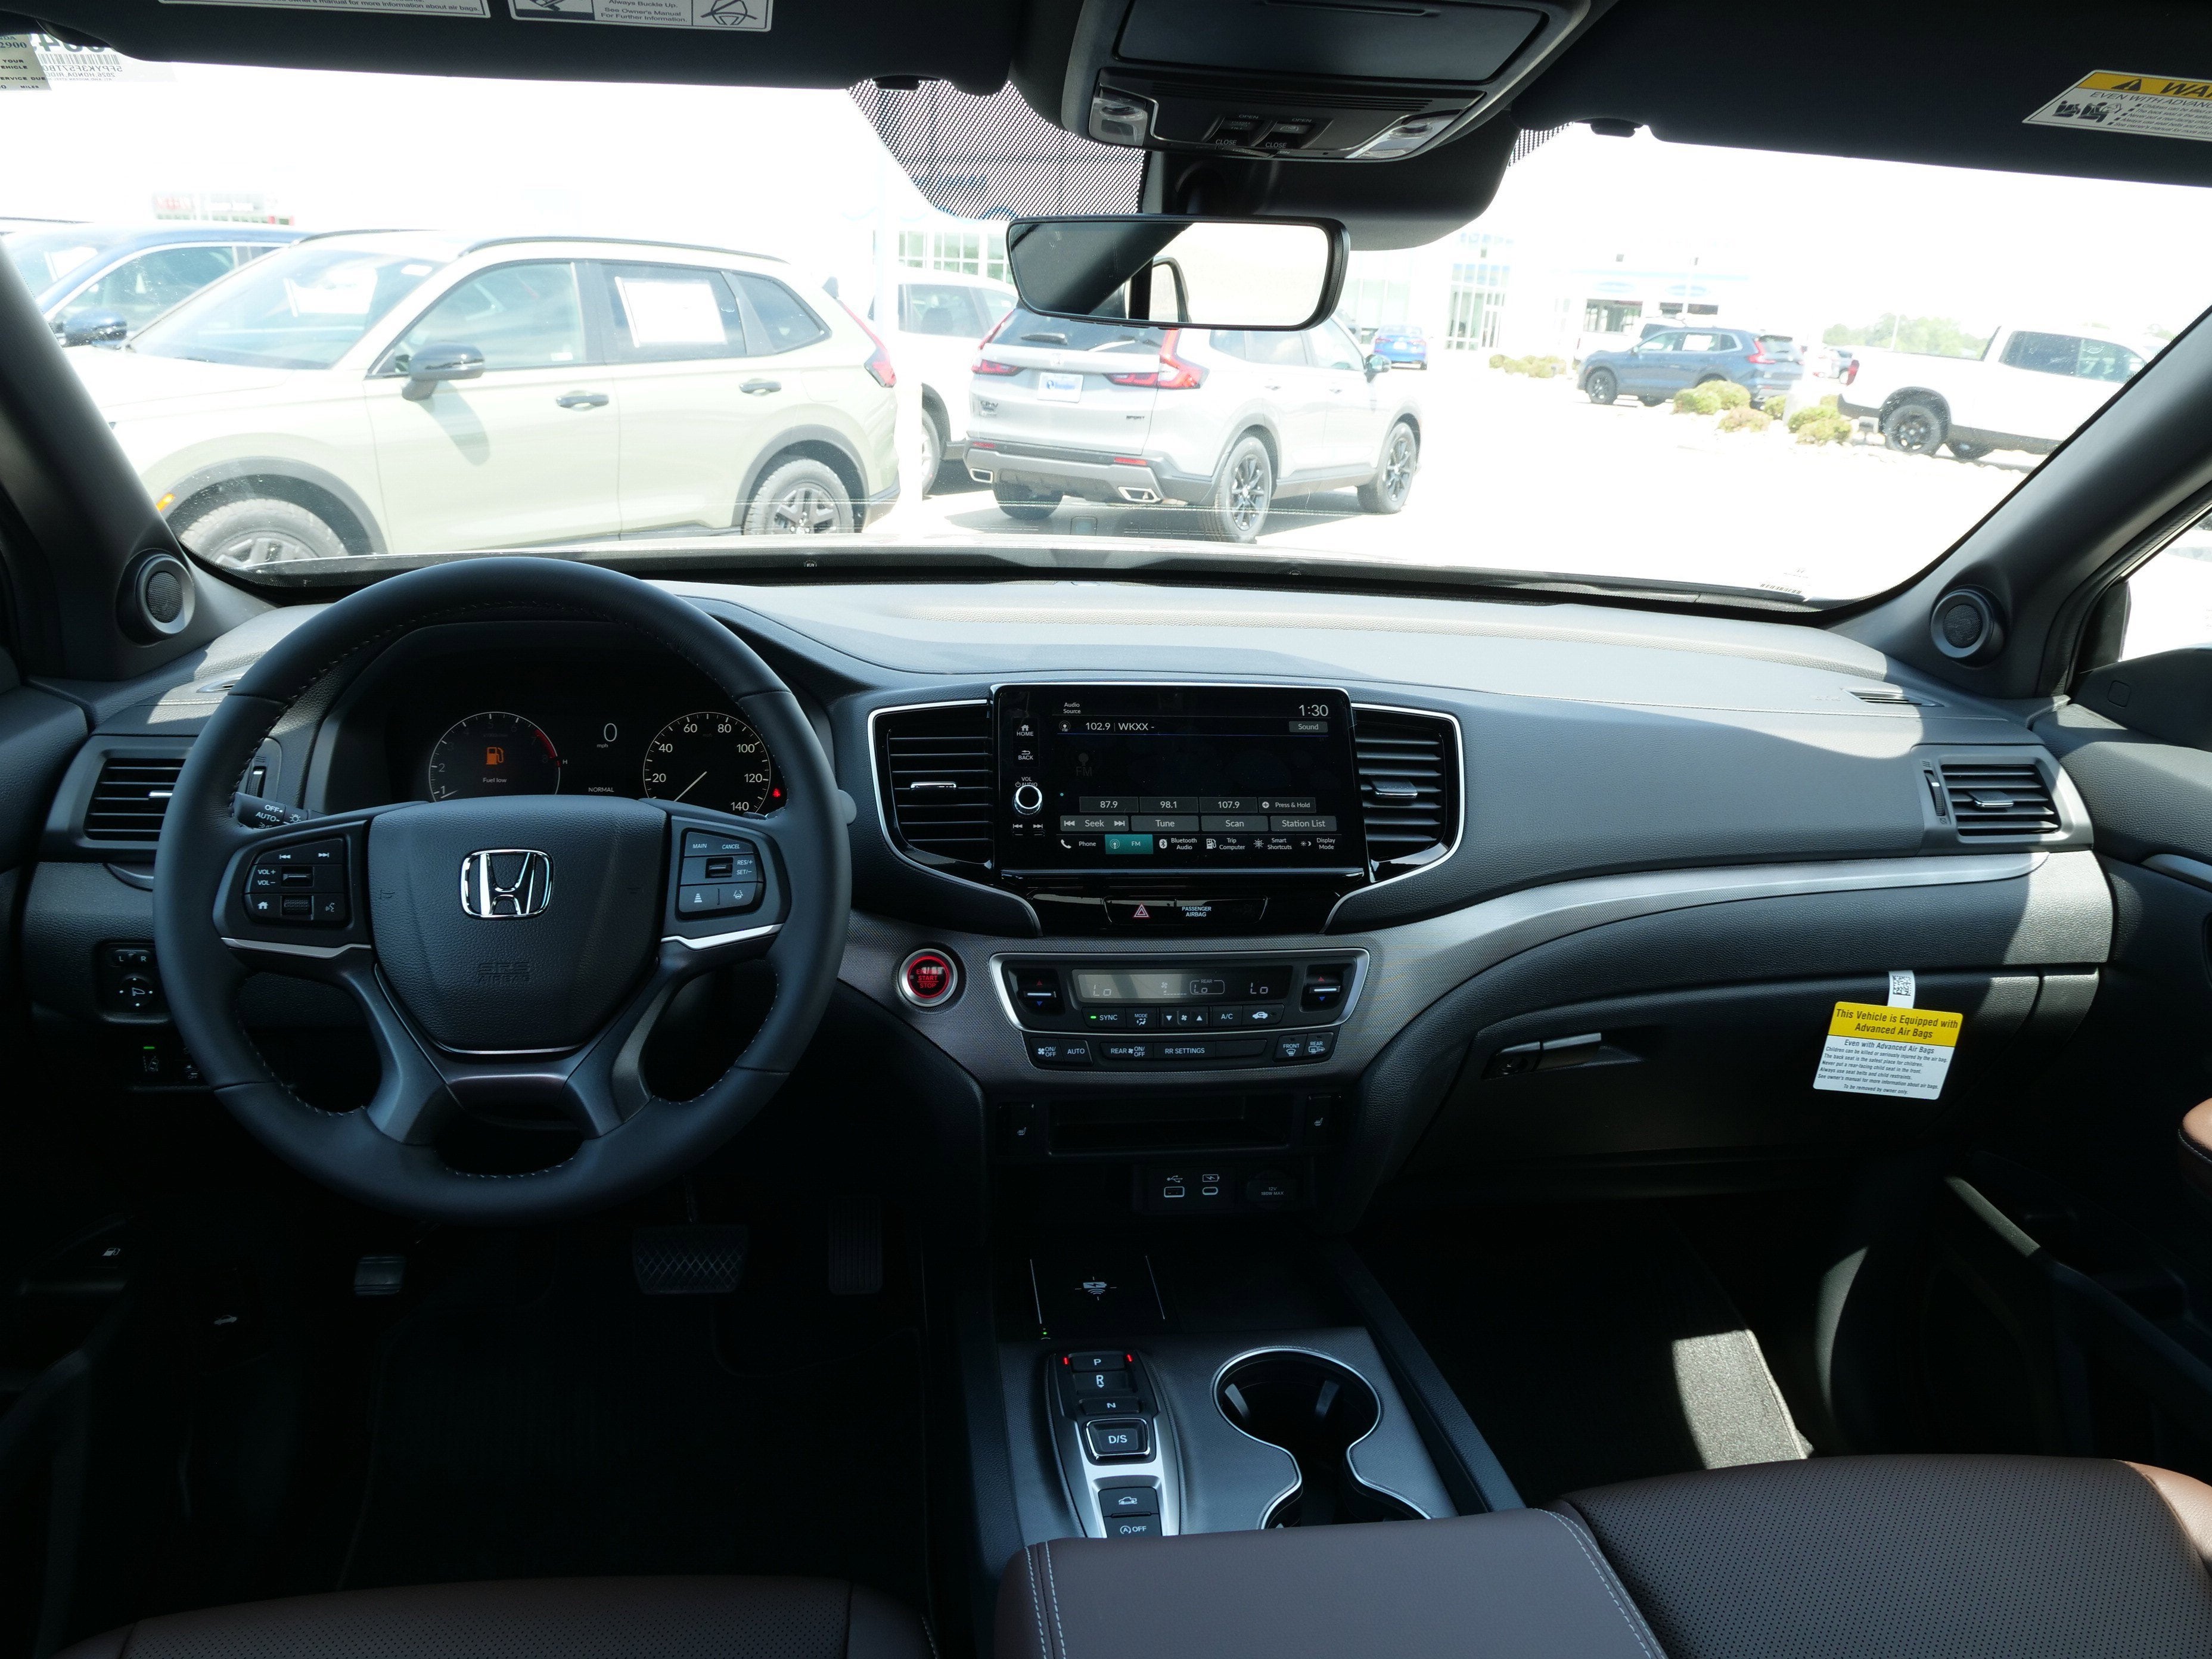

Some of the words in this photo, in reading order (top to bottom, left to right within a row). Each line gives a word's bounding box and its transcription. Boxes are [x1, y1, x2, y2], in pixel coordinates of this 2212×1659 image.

[2090, 91, 2128, 101] EVEN
[1298, 704, 1329, 717] 1:30
[683, 723, 698, 734] 60
[717, 723, 732, 734] 80
[1085, 722, 1111, 731] 102.9
[603, 722, 619, 743] 0
[658, 743, 673, 753] 40
[736, 743, 755, 753] 100
[438, 763, 445, 772] 2
[652, 773, 667, 783] 20
[744, 773, 763, 783] 120
[440, 785, 446, 794] 1
[265, 804, 280, 813] OFF
[730, 801, 750, 811] 140
[255, 812, 276, 822] AUTO
[1250, 983, 1269, 994] Lo
[1836, 1009, 1853, 1018] This
[1856, 1011, 1887, 1023] Vehicle
[1890, 1014, 1897, 1023] is
[1899, 1015, 1938, 1027] Equipped
[1940, 1020, 1958, 1029] with
[1854, 1023, 1896, 1034] Advanced
[1912, 1029, 1933, 1039] Bags
[1876, 1042, 1907, 1051] Advanced
[1919, 1046, 1935, 1055] Bags
[1096, 1375, 1104, 1385] R
[1108, 1435, 1127, 1444] D/S
